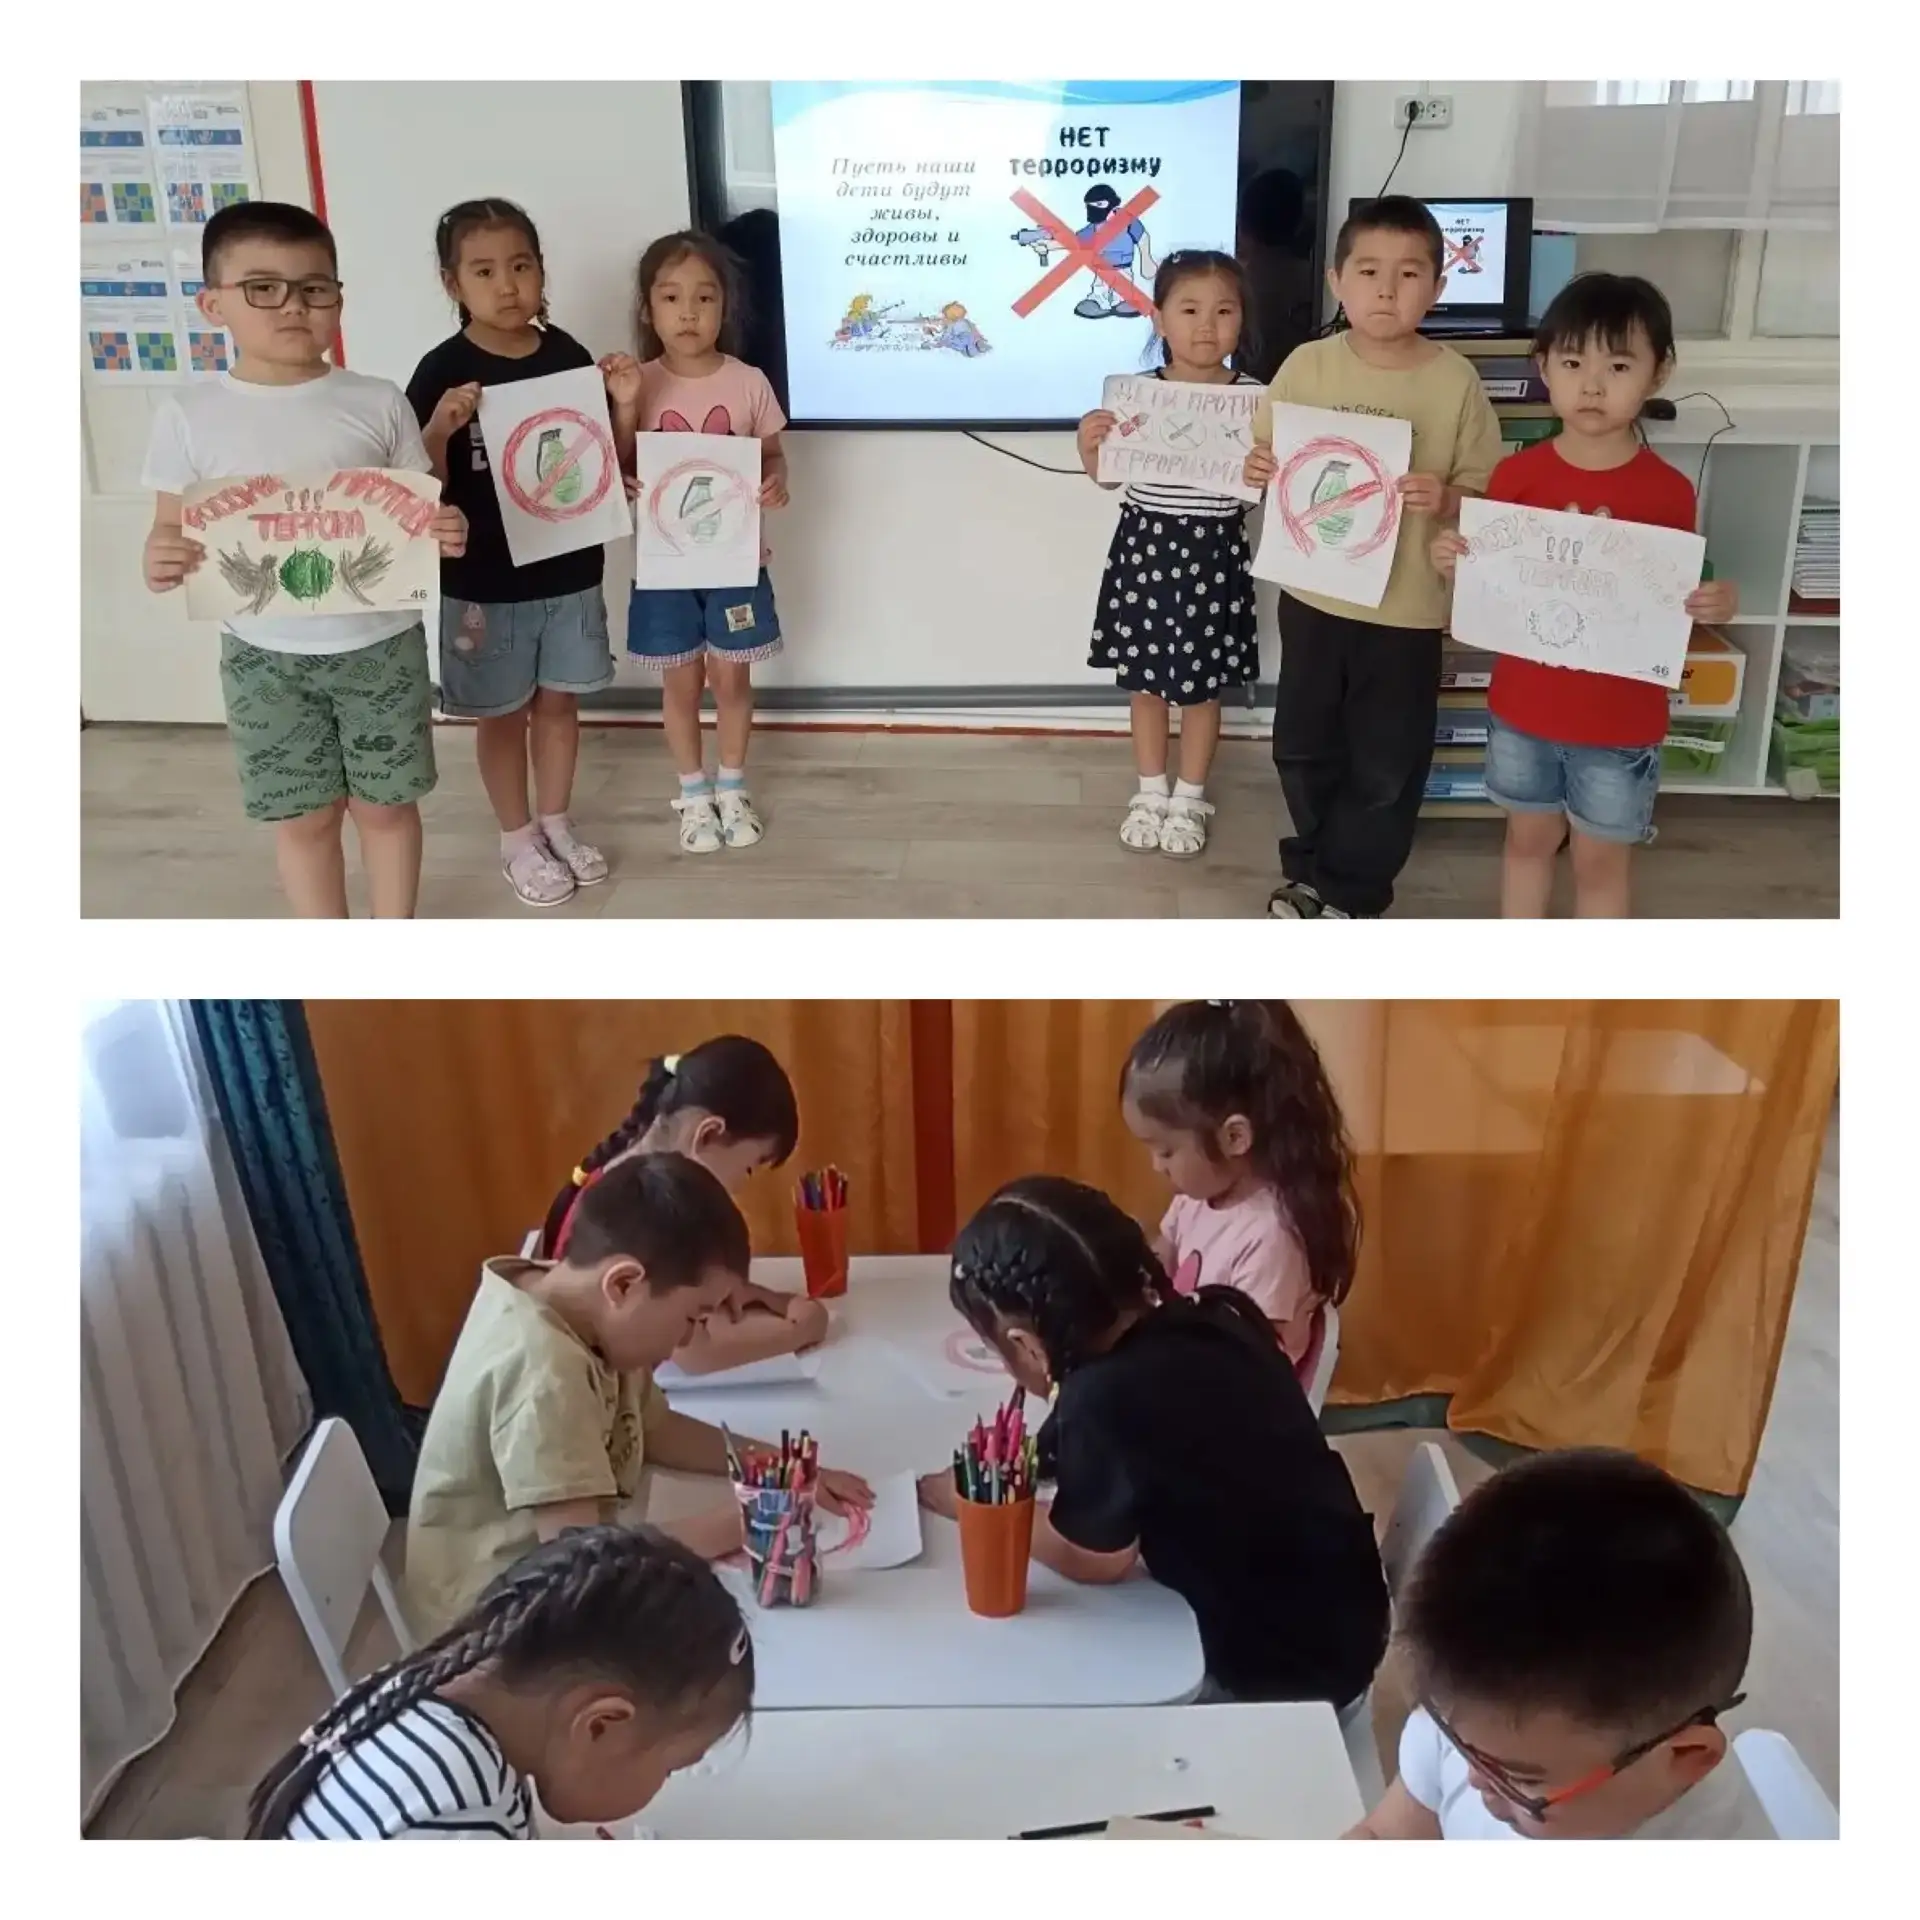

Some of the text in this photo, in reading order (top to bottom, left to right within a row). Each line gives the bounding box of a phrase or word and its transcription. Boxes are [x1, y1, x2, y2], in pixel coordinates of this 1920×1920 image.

[1059, 126, 1111, 148] НЕТ
[831, 157, 976, 179] Пусть наши
[1009, 156, 1162, 178] терроризму
[835, 180, 971, 201] дети будут
[850, 227, 960, 247] здоровы и
[844, 253, 968, 267] счастливы
[410, 588, 428, 600] 46
[1651, 663, 1670, 677] 46
